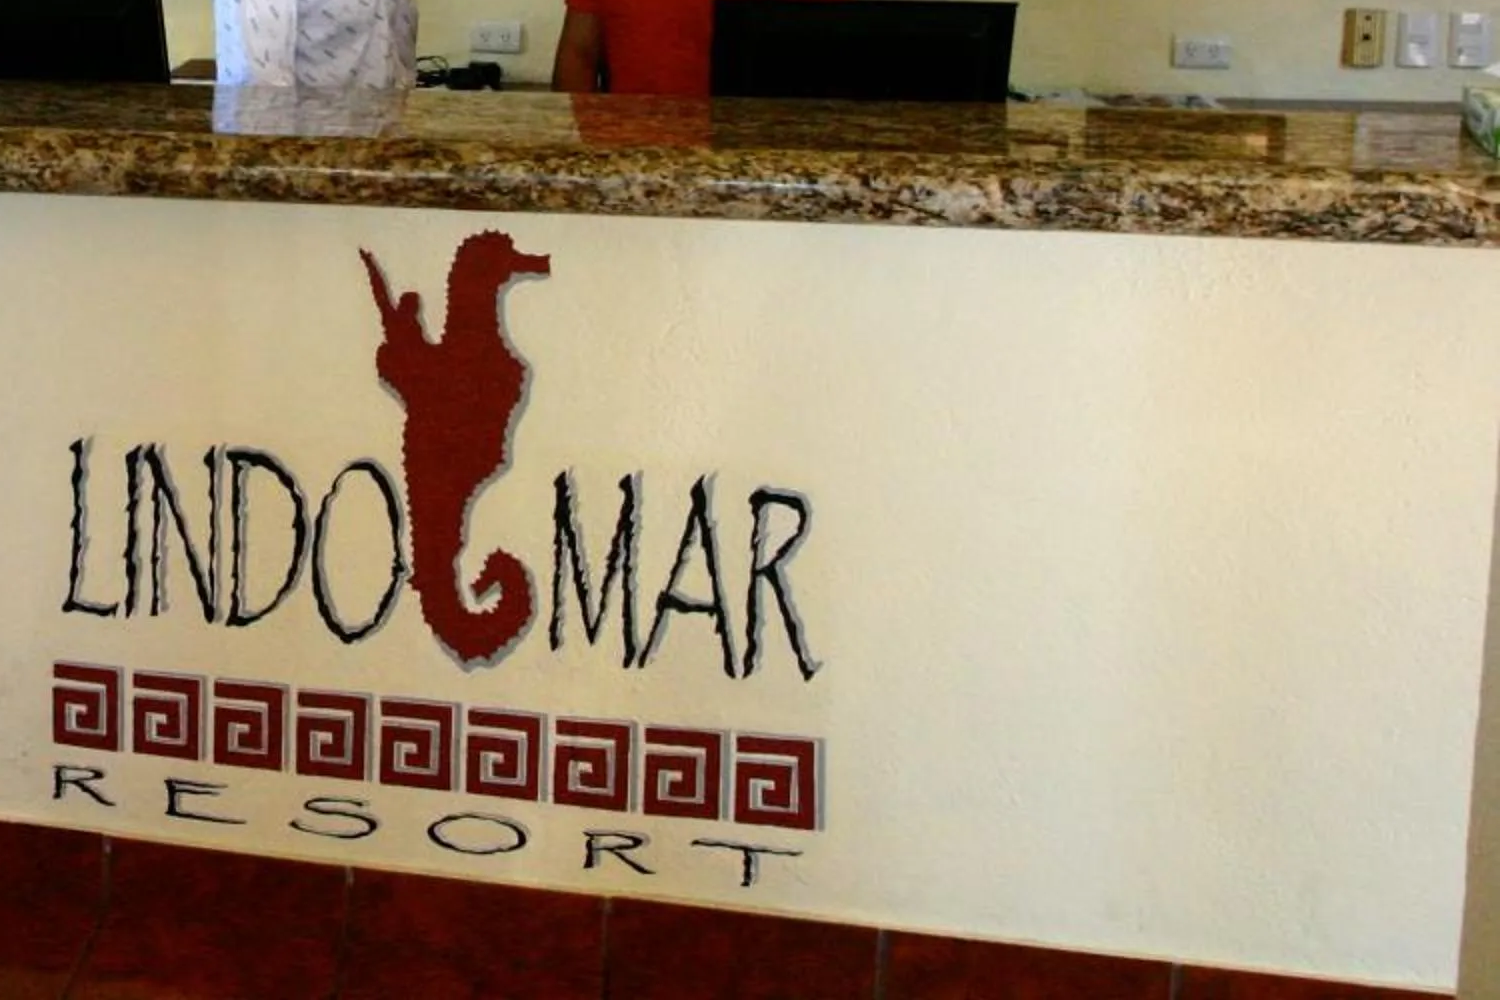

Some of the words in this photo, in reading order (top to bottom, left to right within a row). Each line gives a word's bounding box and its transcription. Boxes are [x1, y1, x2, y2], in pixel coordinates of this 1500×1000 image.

[62, 438, 408, 646] LINDO
[550, 466, 820, 682] MAR
[52, 765, 803, 887] RESORT
